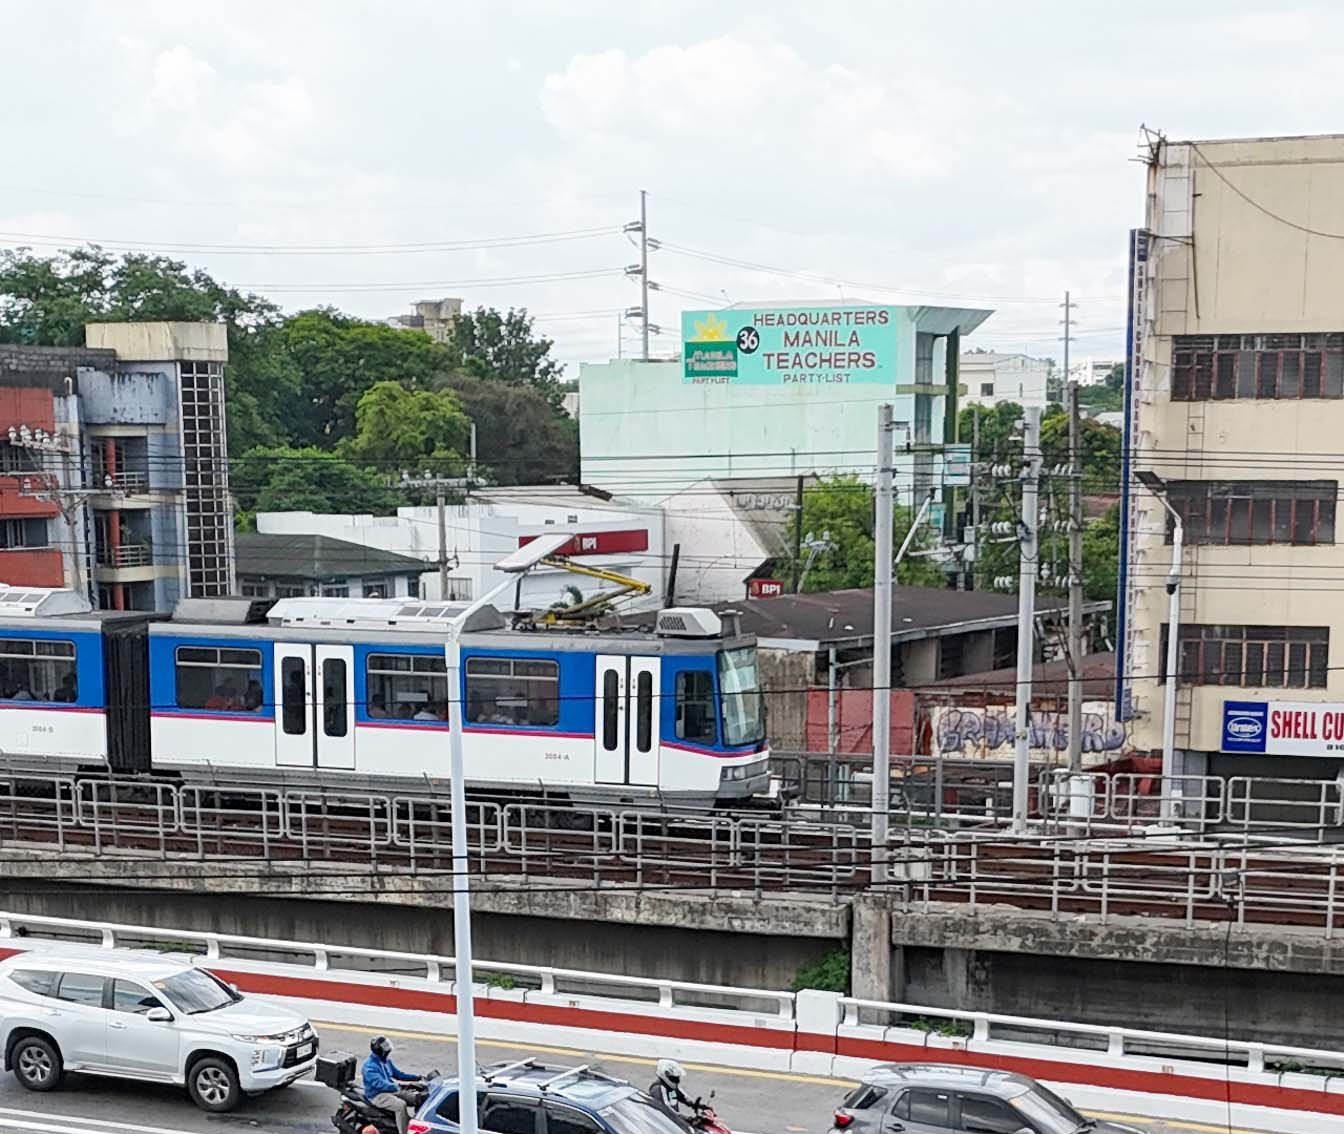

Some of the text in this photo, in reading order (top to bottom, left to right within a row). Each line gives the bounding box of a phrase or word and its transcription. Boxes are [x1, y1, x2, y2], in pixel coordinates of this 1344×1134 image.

[753, 310, 890, 327] HEADQUARTERS
[739, 330, 758, 350] 36
[783, 330, 861, 348] MANILA
[762, 351, 876, 370] TEACHERS
[582, 537, 597, 550] BPI
[761, 584, 781, 595] BPI
[1270, 710, 1317, 740] SHELL
